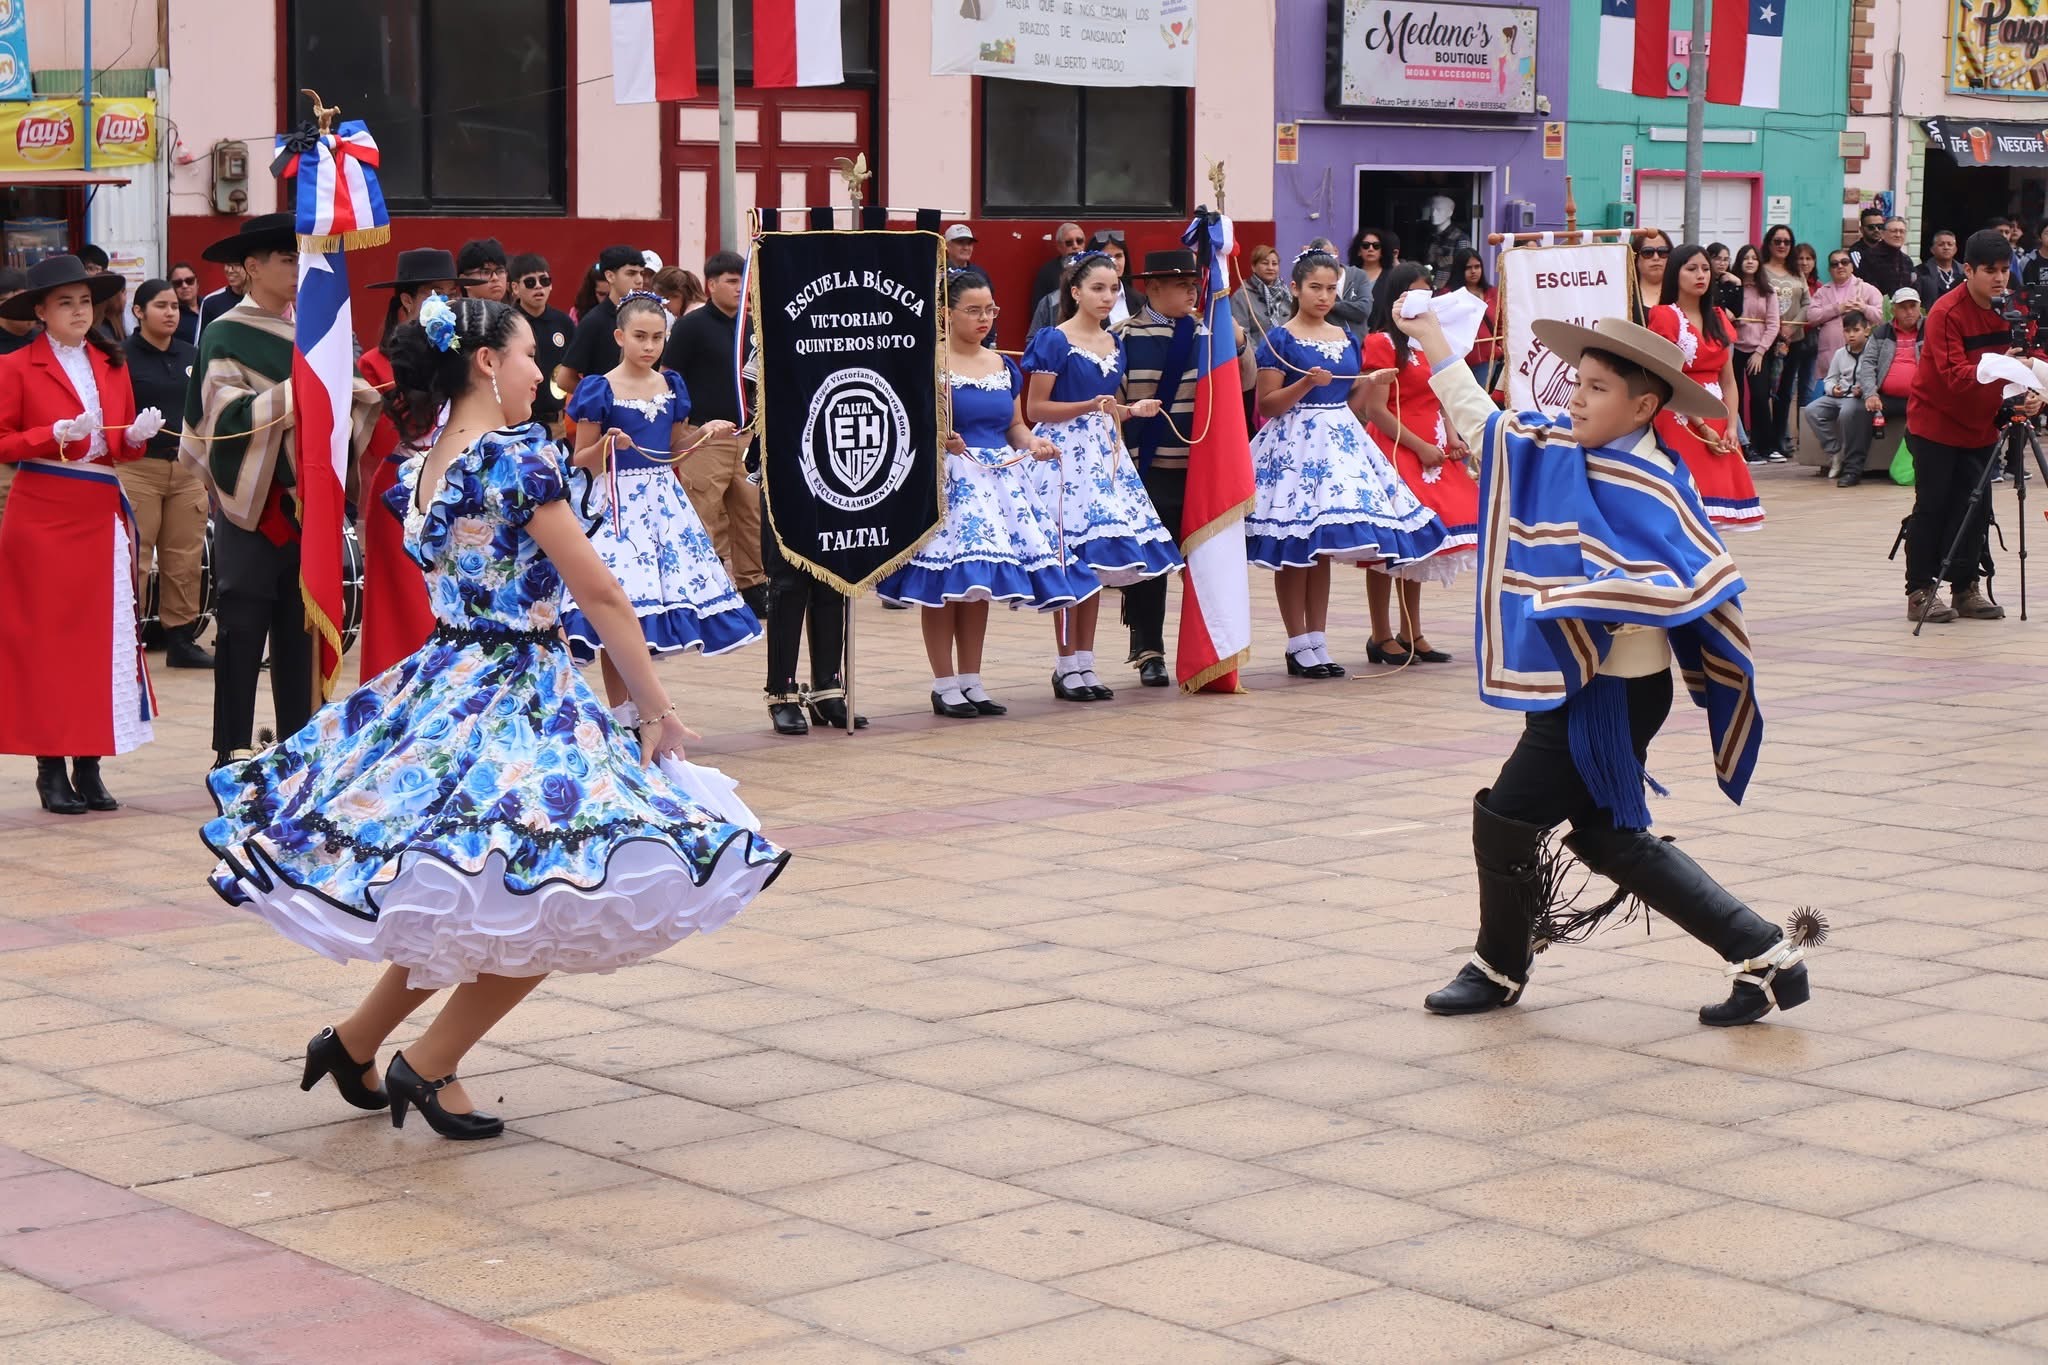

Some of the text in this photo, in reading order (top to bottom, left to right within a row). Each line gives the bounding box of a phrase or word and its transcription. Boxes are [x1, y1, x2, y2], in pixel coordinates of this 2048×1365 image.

[1135, 7, 1150, 21] LOS
[1018, 21, 1050, 36] BRAZOS
[1060, 25, 1071, 38] DE
[1365, 9, 1493, 63] Medano's
[1033, 52, 1124, 72] SAN ALBERTO HURTADO
[1435, 51, 1488, 65] BOUTIQUE
[1406, 68, 1430, 77] MODA
[1439, 70, 1490, 80] ACCESORIOS
[19, 118, 70, 148] Lay's
[98, 115, 146, 144] Lay's
[1536, 270, 1608, 289] ESCUELA
[785, 270, 926, 321] ESCUELA BÁSICA
[810, 311, 894, 329] VICTORIANO
[795, 334, 916, 355] QUINTEROS SOTO
[804, 406, 818, 443] Escuela
[814, 381, 832, 406] Hogar
[829, 370, 874, 385] Victoriano
[836, 402, 874, 416] TALTAL
[834, 415, 881, 449] EH
[818, 526, 890, 552] TALTAL
